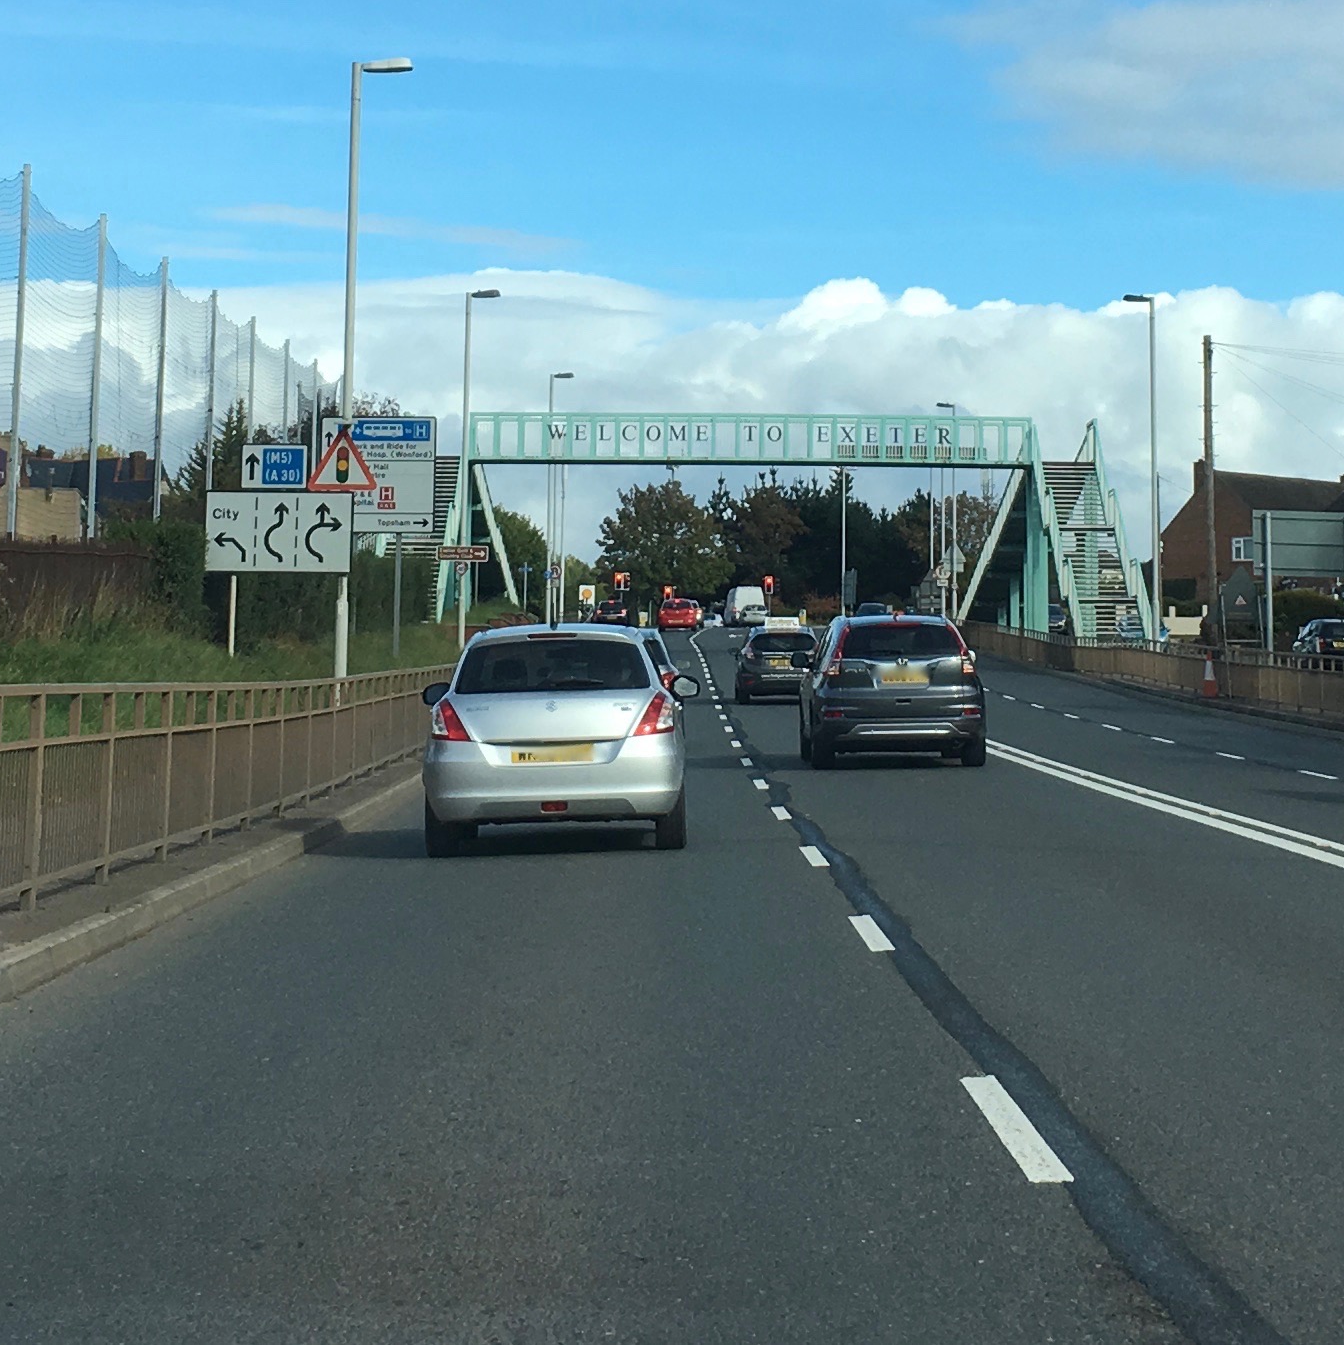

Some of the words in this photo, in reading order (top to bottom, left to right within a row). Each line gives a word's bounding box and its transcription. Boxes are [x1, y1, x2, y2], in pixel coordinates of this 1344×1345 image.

[546, 422, 710, 443] WELCOME
[743, 424, 784, 443] TO
[817, 424, 953, 446] EXETER
[387, 442, 404, 450] Ride
[406, 442, 417, 450] for
[266, 451, 292, 465] (M5)
[212, 508, 240, 521] City
[377, 519, 411, 527] Topsham
